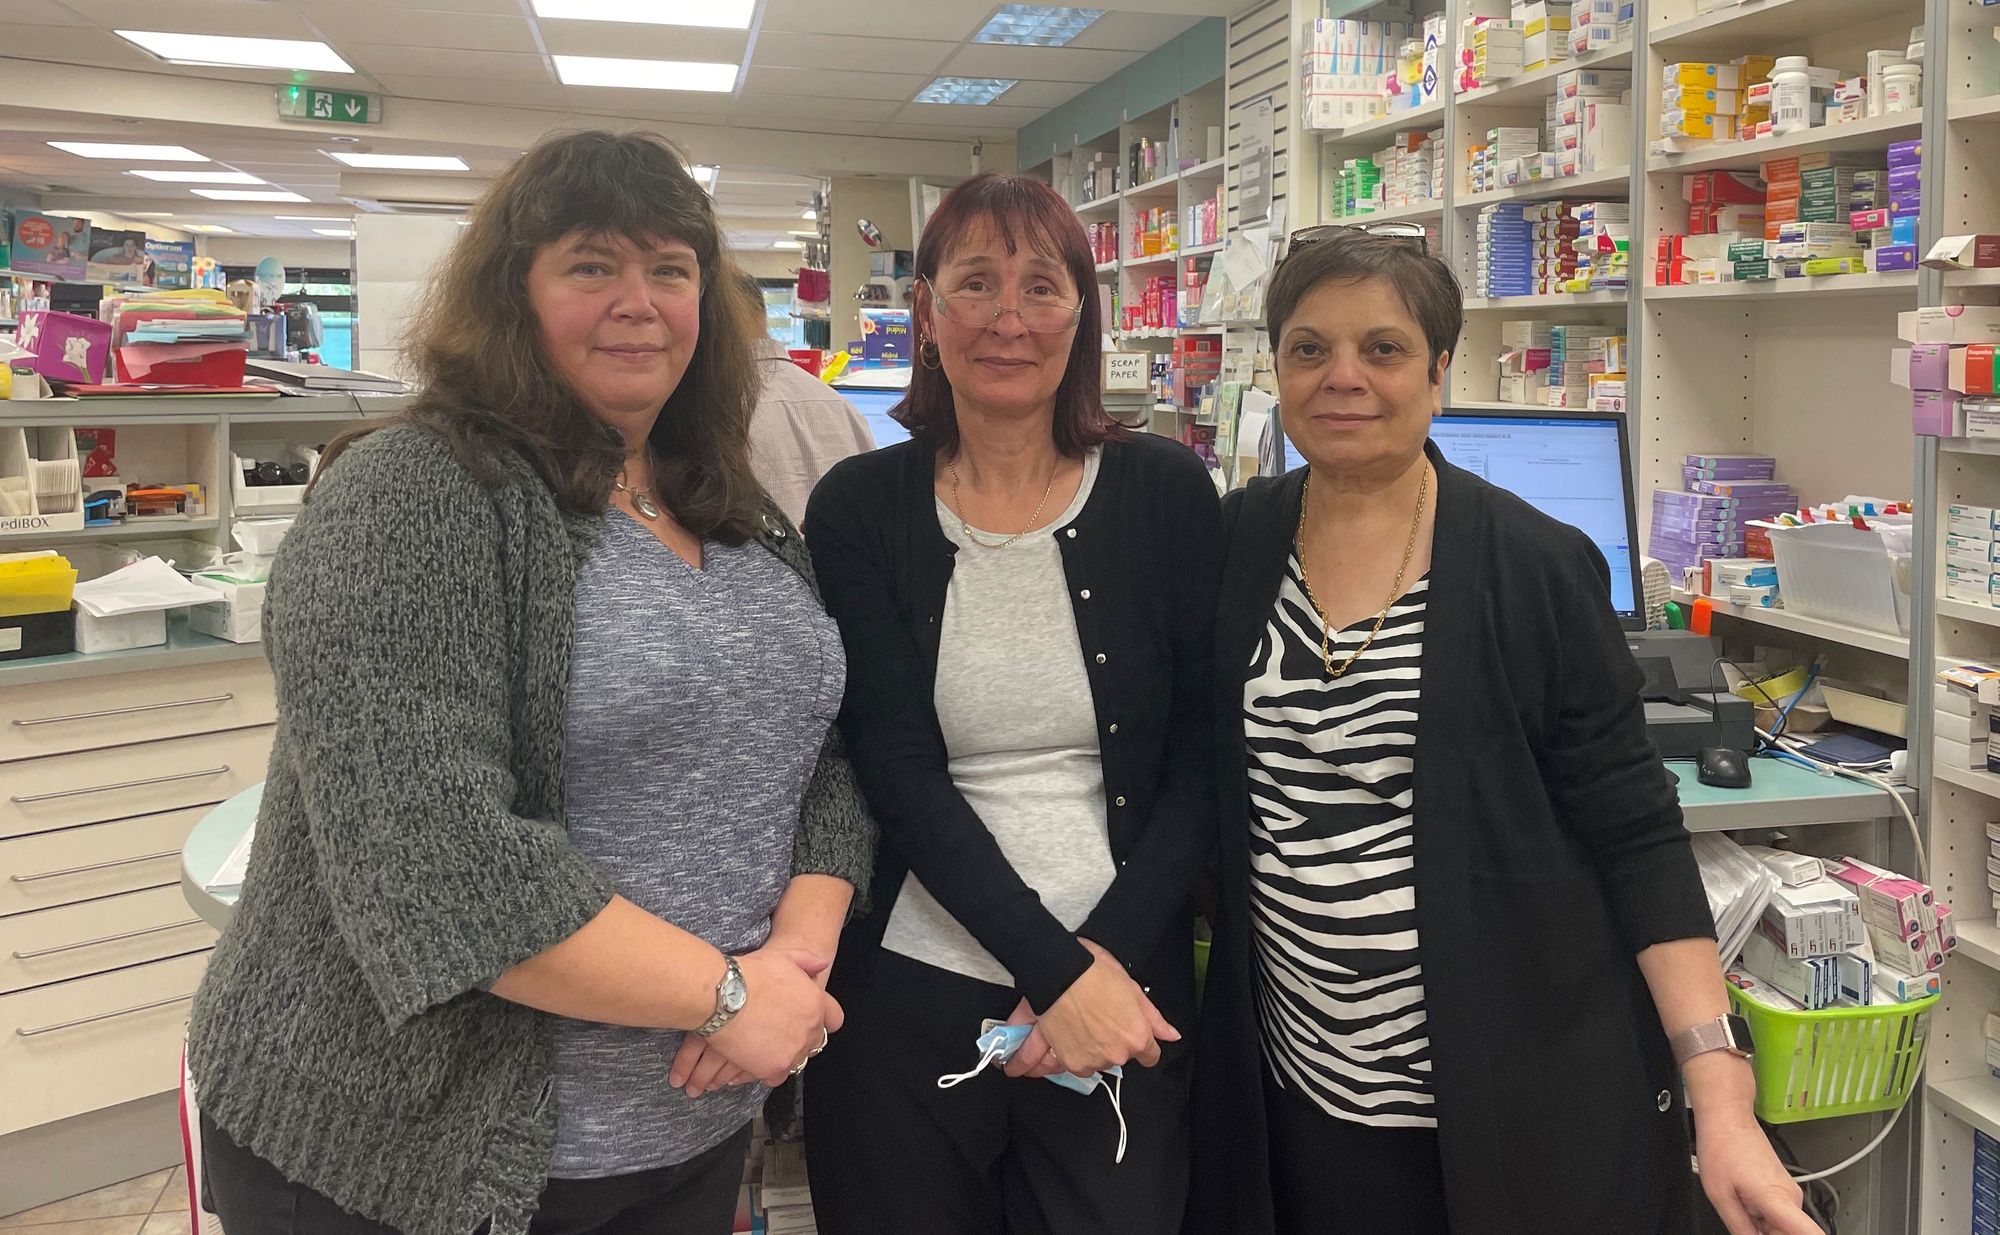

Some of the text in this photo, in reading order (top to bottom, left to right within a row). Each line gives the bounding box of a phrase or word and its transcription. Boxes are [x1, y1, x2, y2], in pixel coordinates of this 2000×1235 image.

[1111, 359, 1140, 368] SCRAP
[1110, 370, 1138, 379] PAPER
[0, 518, 49, 529] ediBOX
